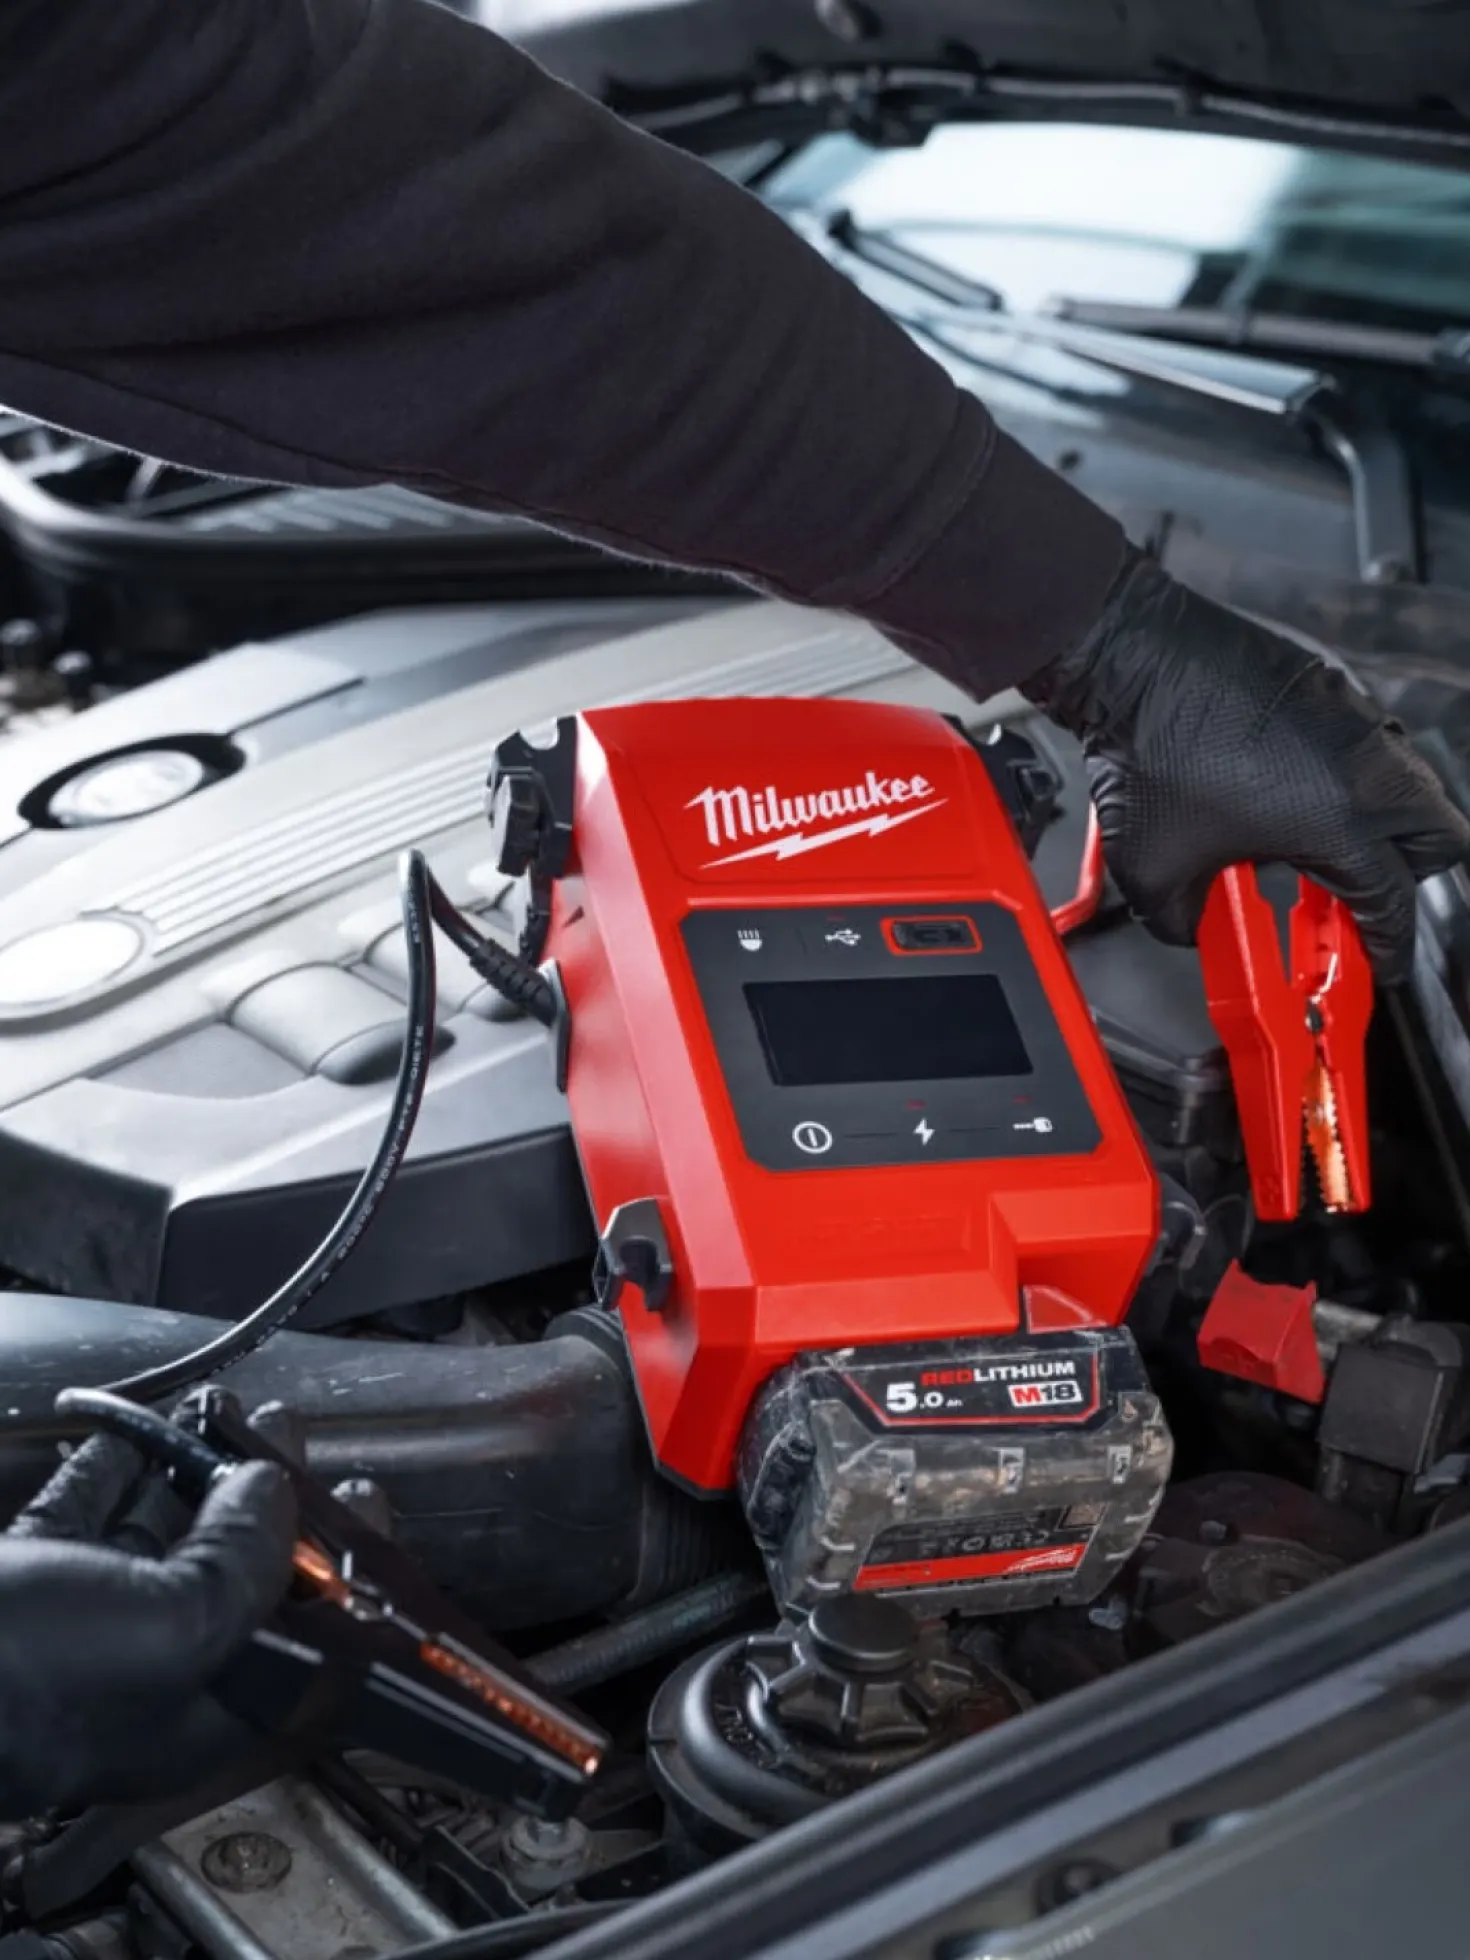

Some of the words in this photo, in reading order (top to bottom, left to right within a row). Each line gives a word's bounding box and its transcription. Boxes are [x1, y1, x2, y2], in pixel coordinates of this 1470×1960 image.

[683, 770, 935, 847] Milwaukee
[920, 1360, 1076, 1386] REDLITHIUM
[885, 1382, 944, 1413] 5.0
[1011, 1382, 1077, 1406] M18
